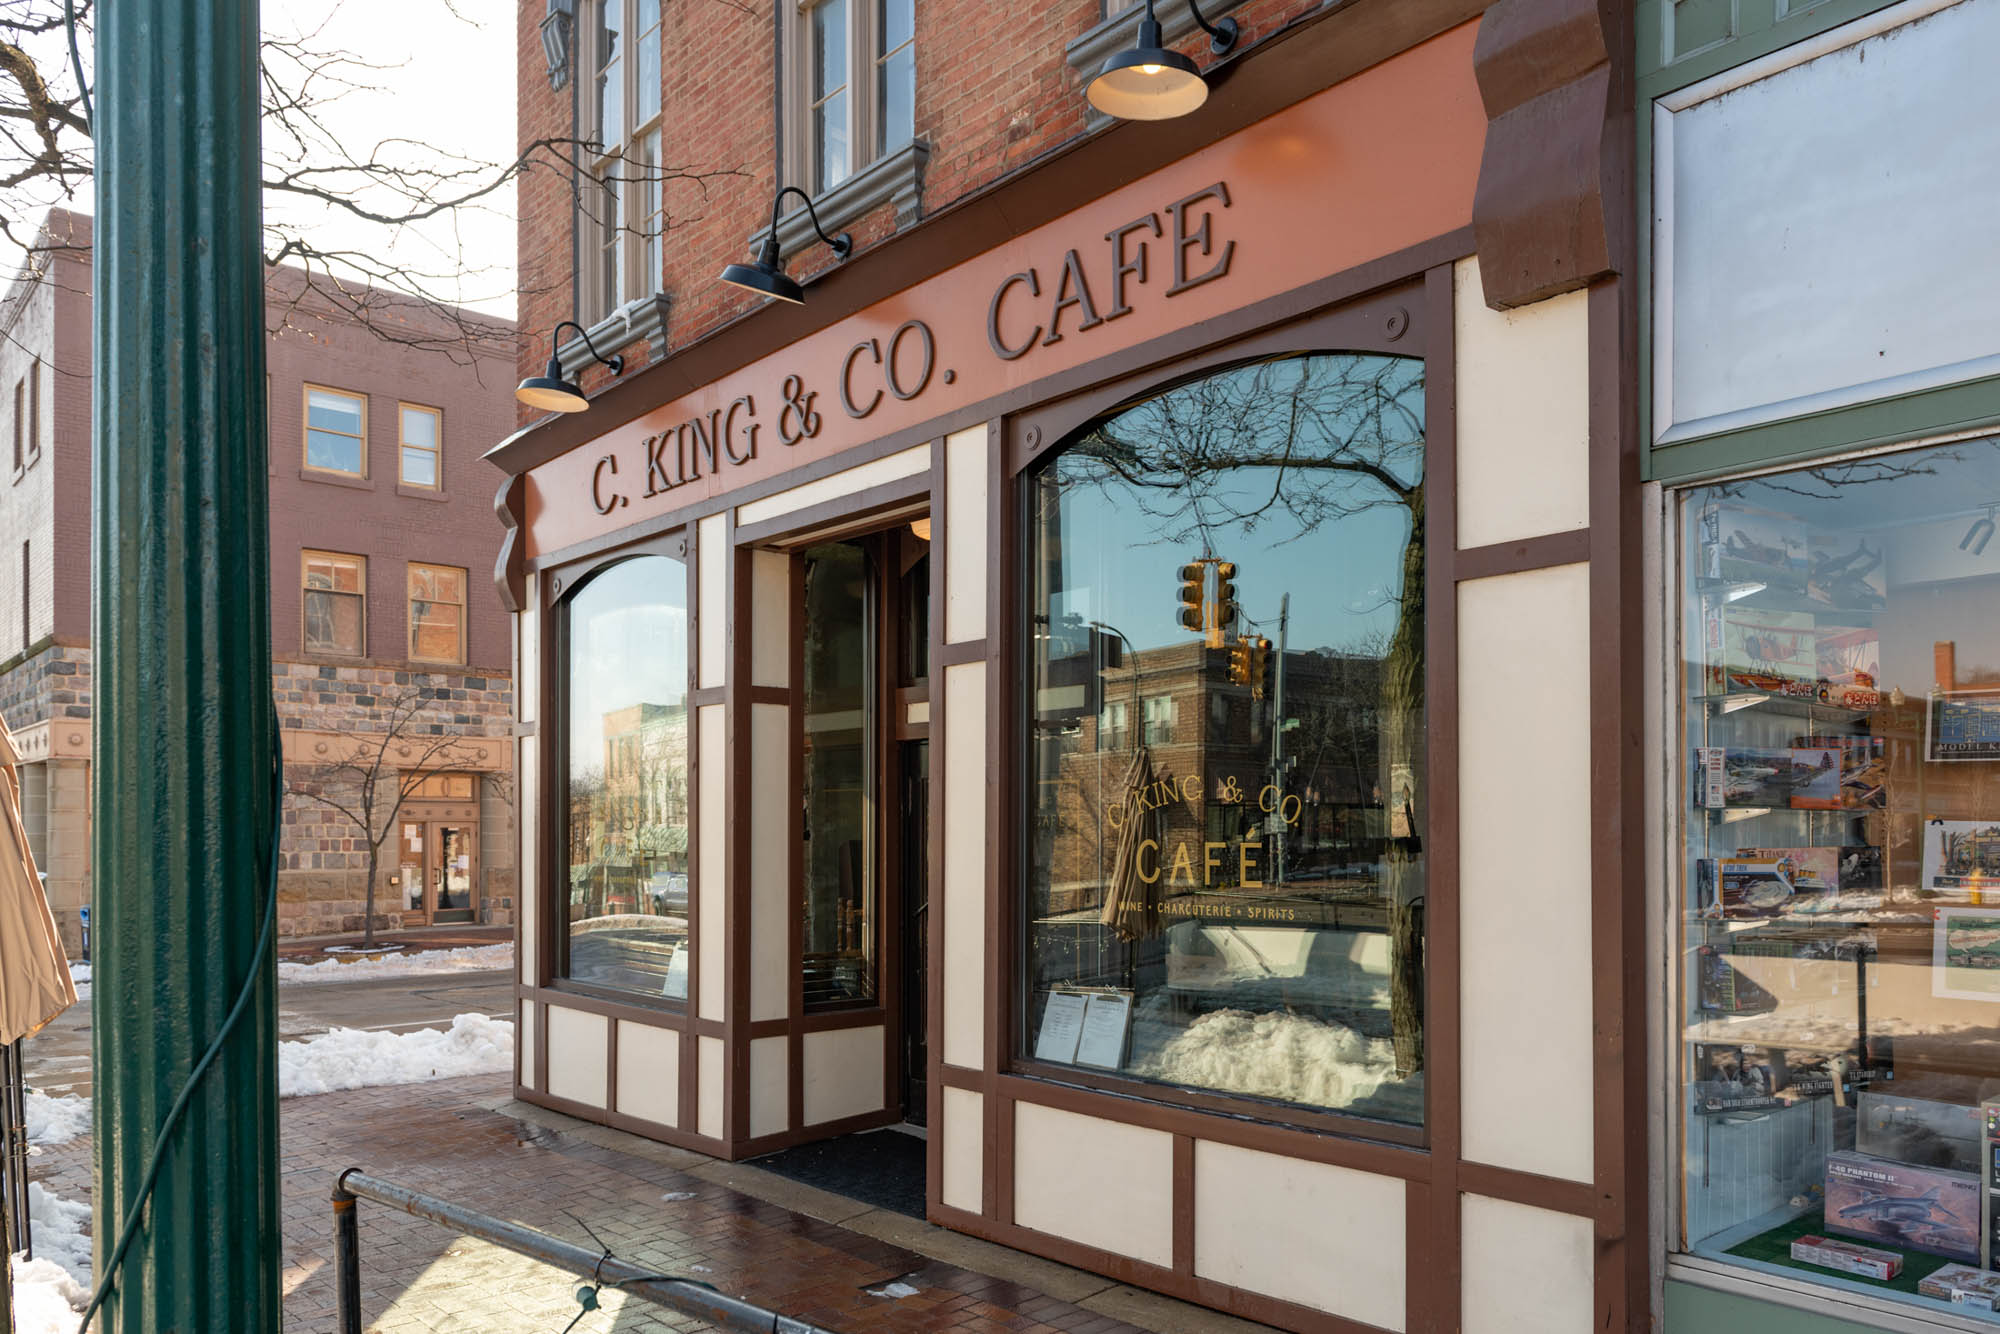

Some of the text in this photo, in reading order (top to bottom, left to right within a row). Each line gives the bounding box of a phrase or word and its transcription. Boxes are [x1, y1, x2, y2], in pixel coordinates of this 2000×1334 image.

[590, 181, 1236, 516] C. KING & CO. CAFE
[1107, 775, 1302, 828] C. KING & CO.
[1135, 826, 1263, 889] CAFÉ
[1118, 901, 1295, 921] WINE CHARCUTERIE SPIRITS
